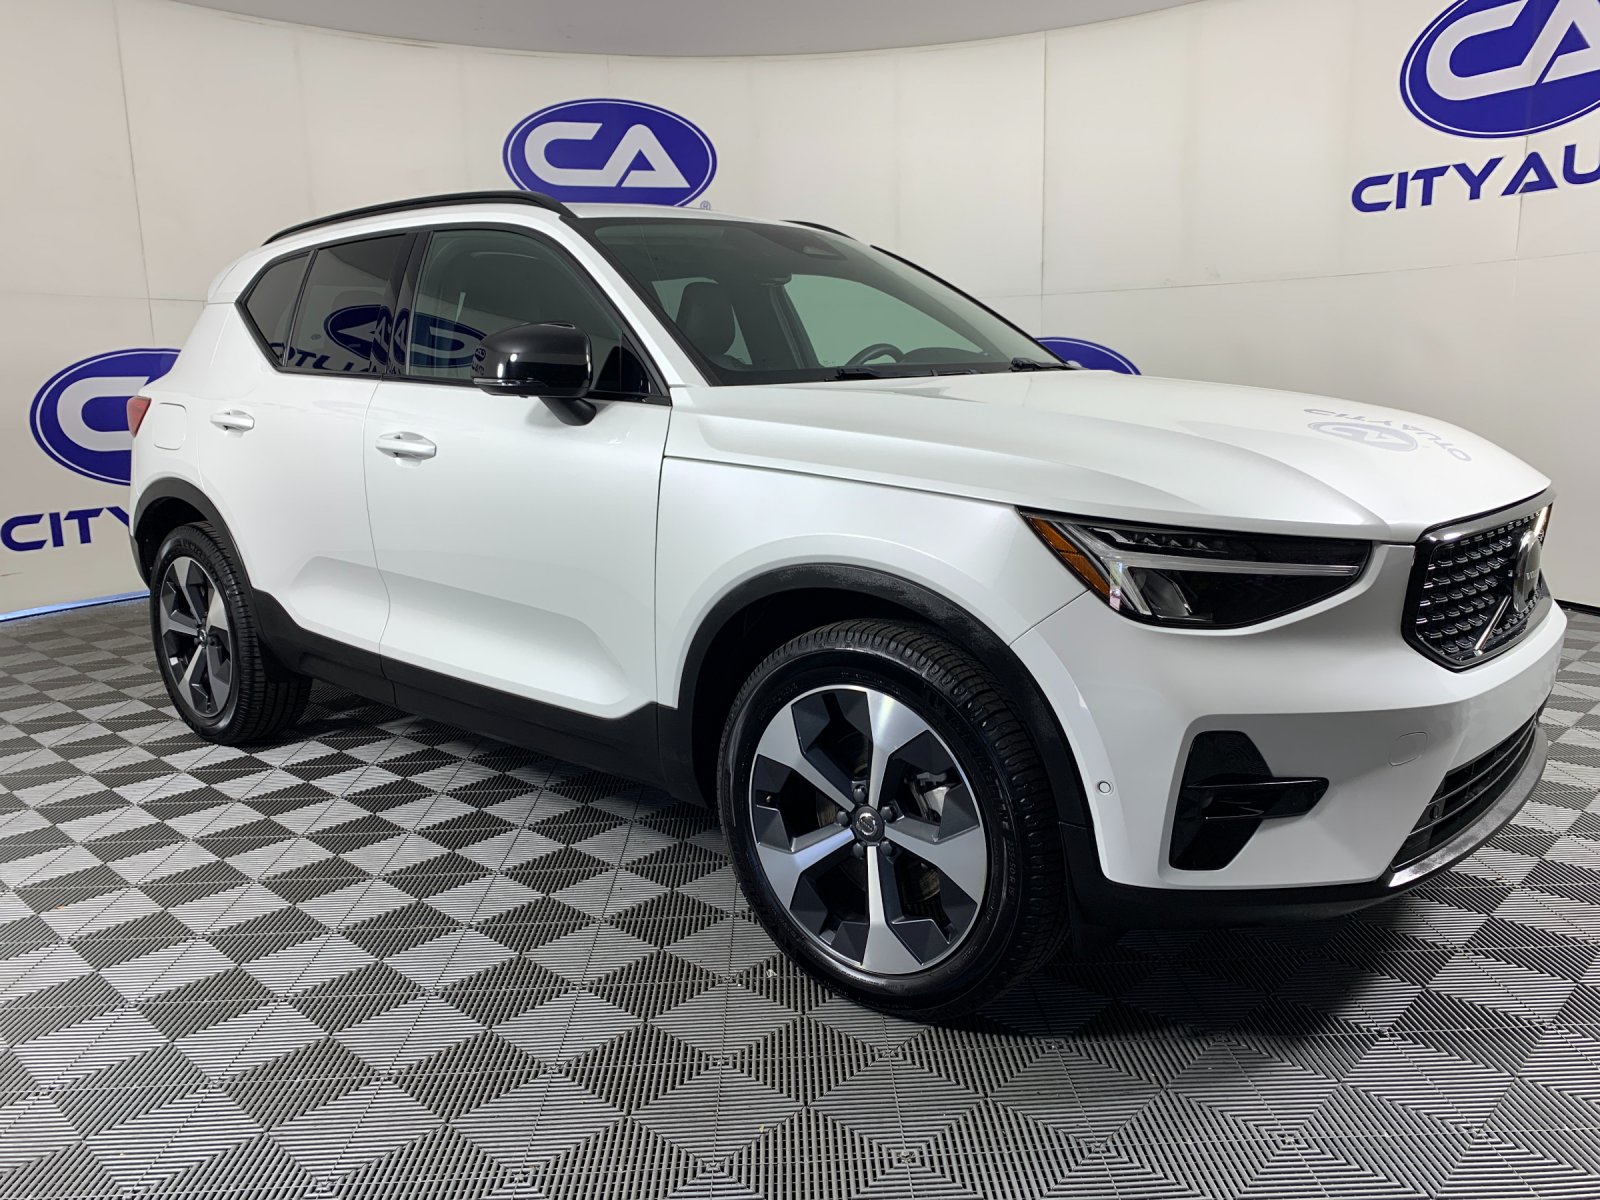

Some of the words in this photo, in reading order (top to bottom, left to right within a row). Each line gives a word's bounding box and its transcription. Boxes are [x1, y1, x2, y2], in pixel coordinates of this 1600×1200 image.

[1426, 0, 1600, 101] CA
[524, 121, 691, 188] CA
[1352, 157, 1505, 213] CITY
